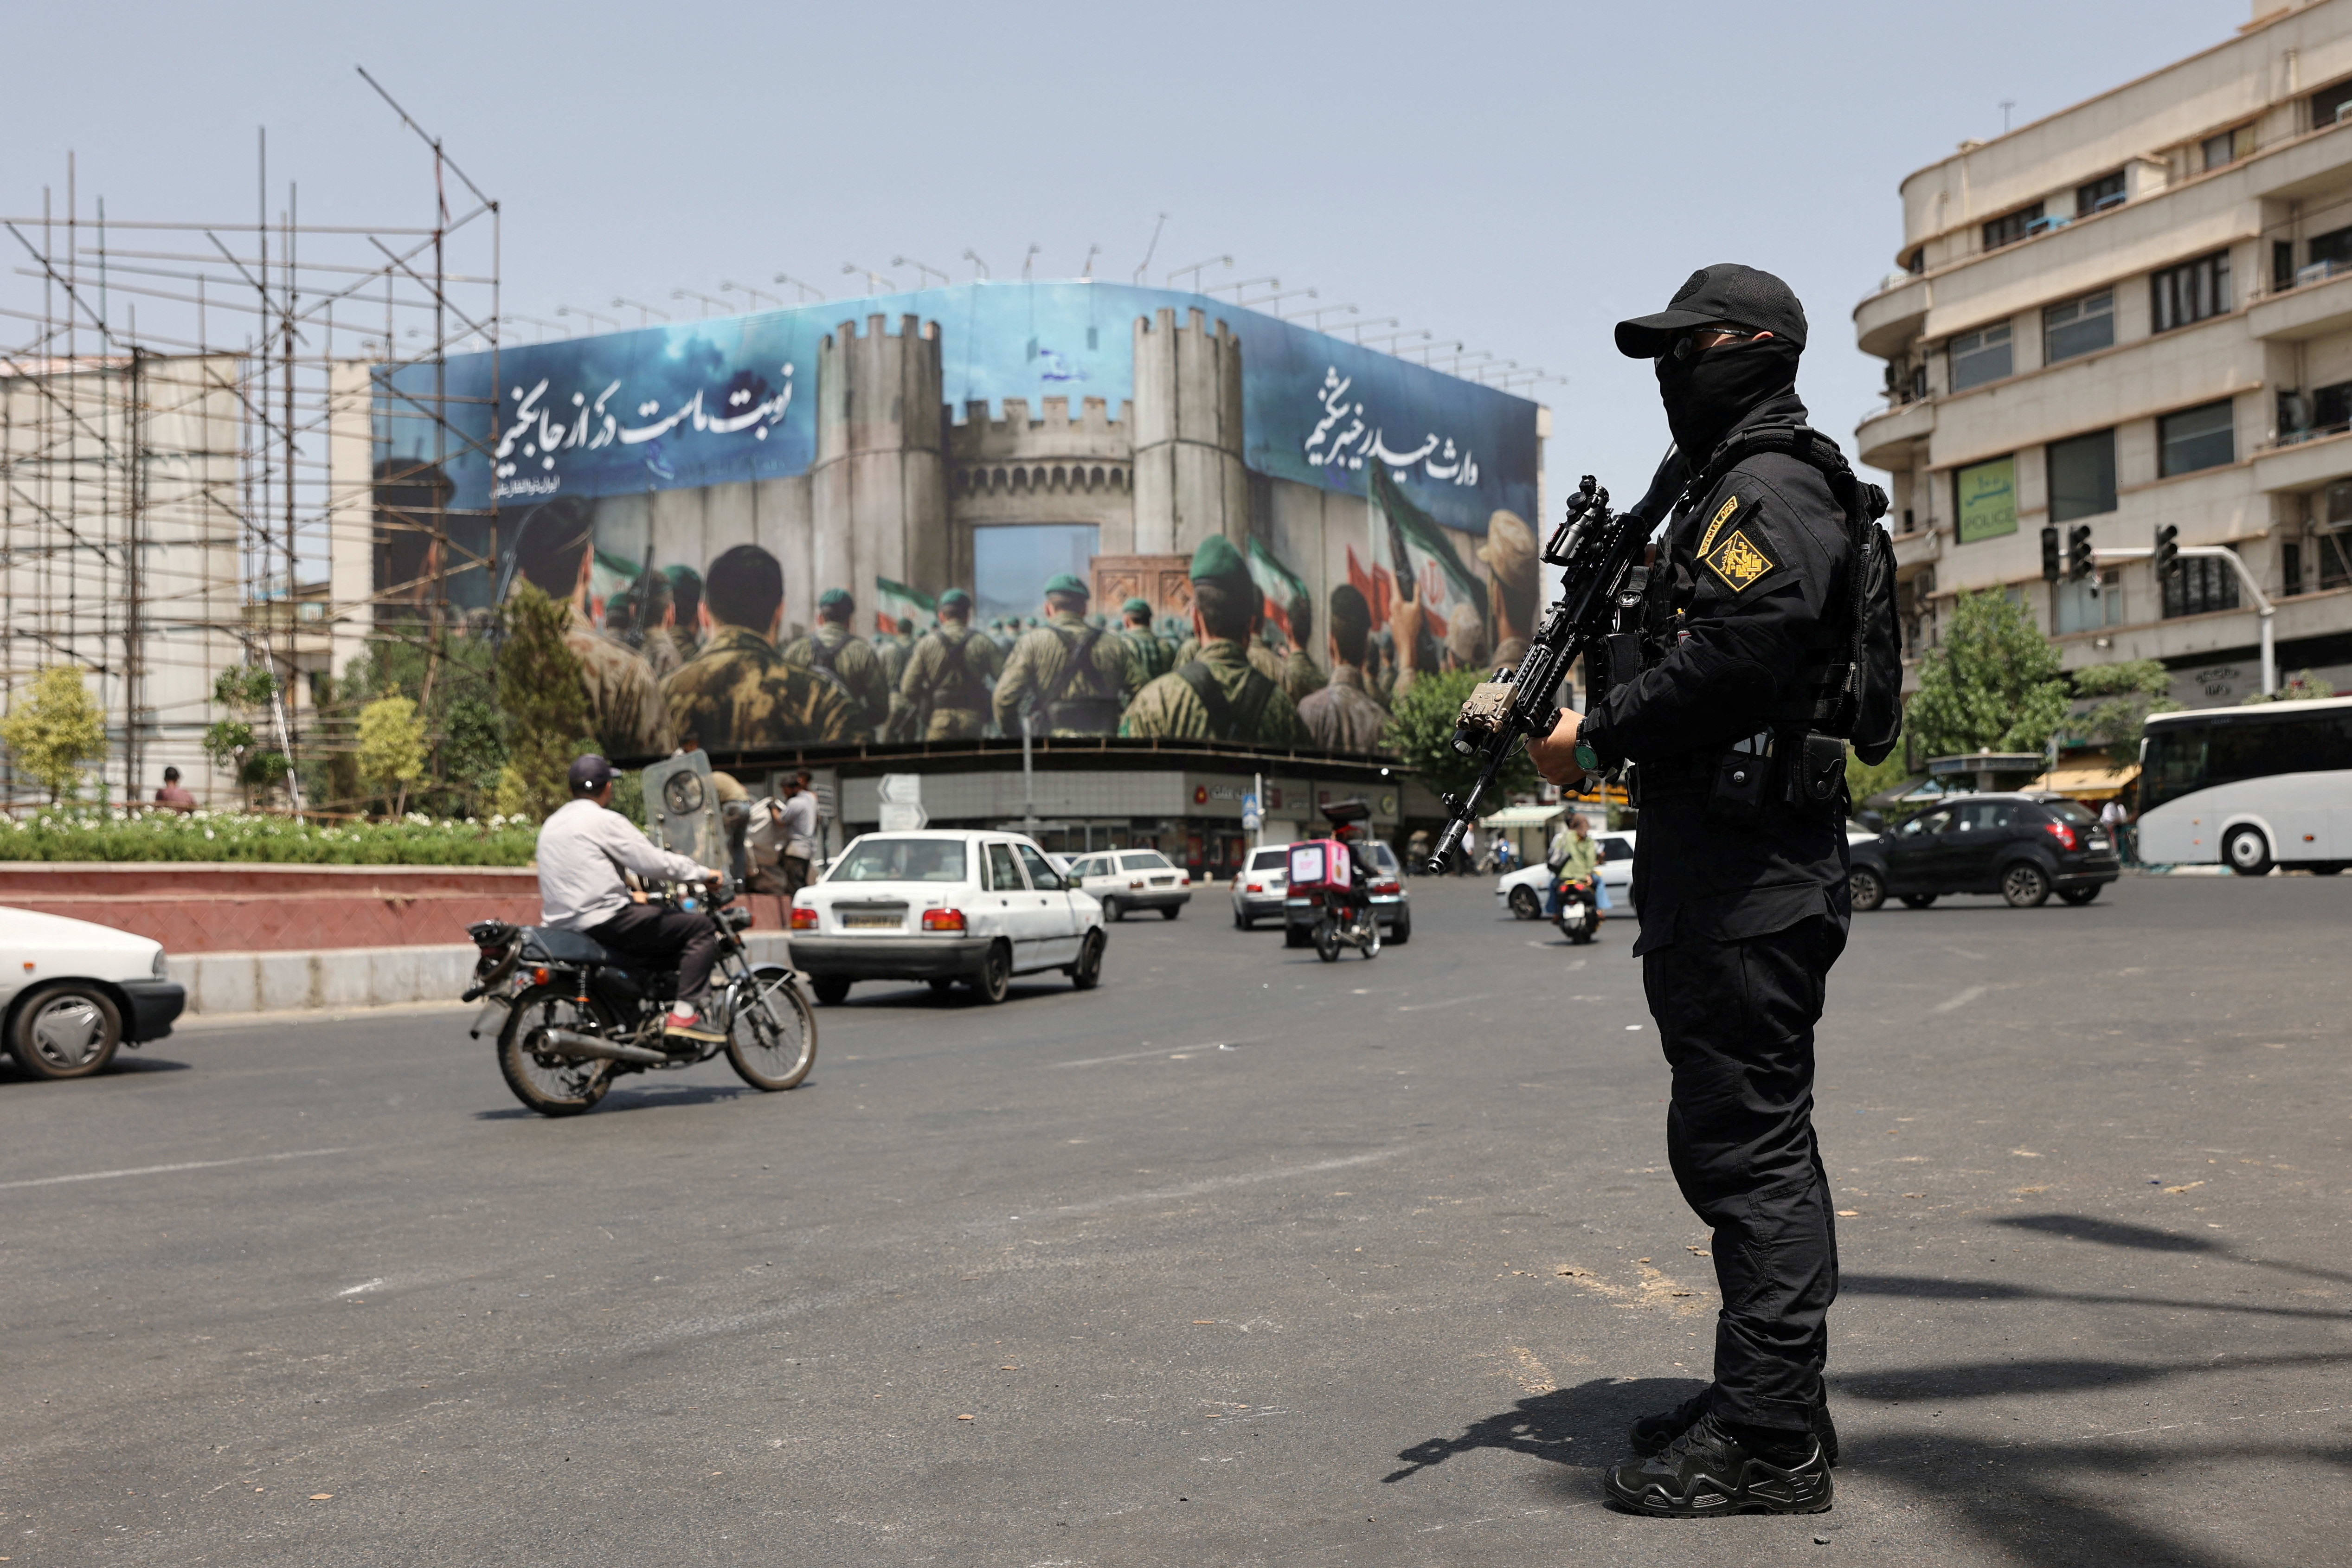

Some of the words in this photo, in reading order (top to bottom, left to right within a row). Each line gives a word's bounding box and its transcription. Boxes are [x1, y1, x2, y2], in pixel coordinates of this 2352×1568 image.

[561, 391, 590, 450] از
[617, 388, 708, 444] ماست
[708, 362, 794, 441] نوبت
[538, 406, 566, 471] جا
[1357, 426, 1440, 484] حیدر
[1425, 437, 1478, 487] وارث
[1699, 519, 1722, 555] SPECIAL
[1721, 501, 1735, 519] OPS
[1963, 506, 2015, 532] POLICE
